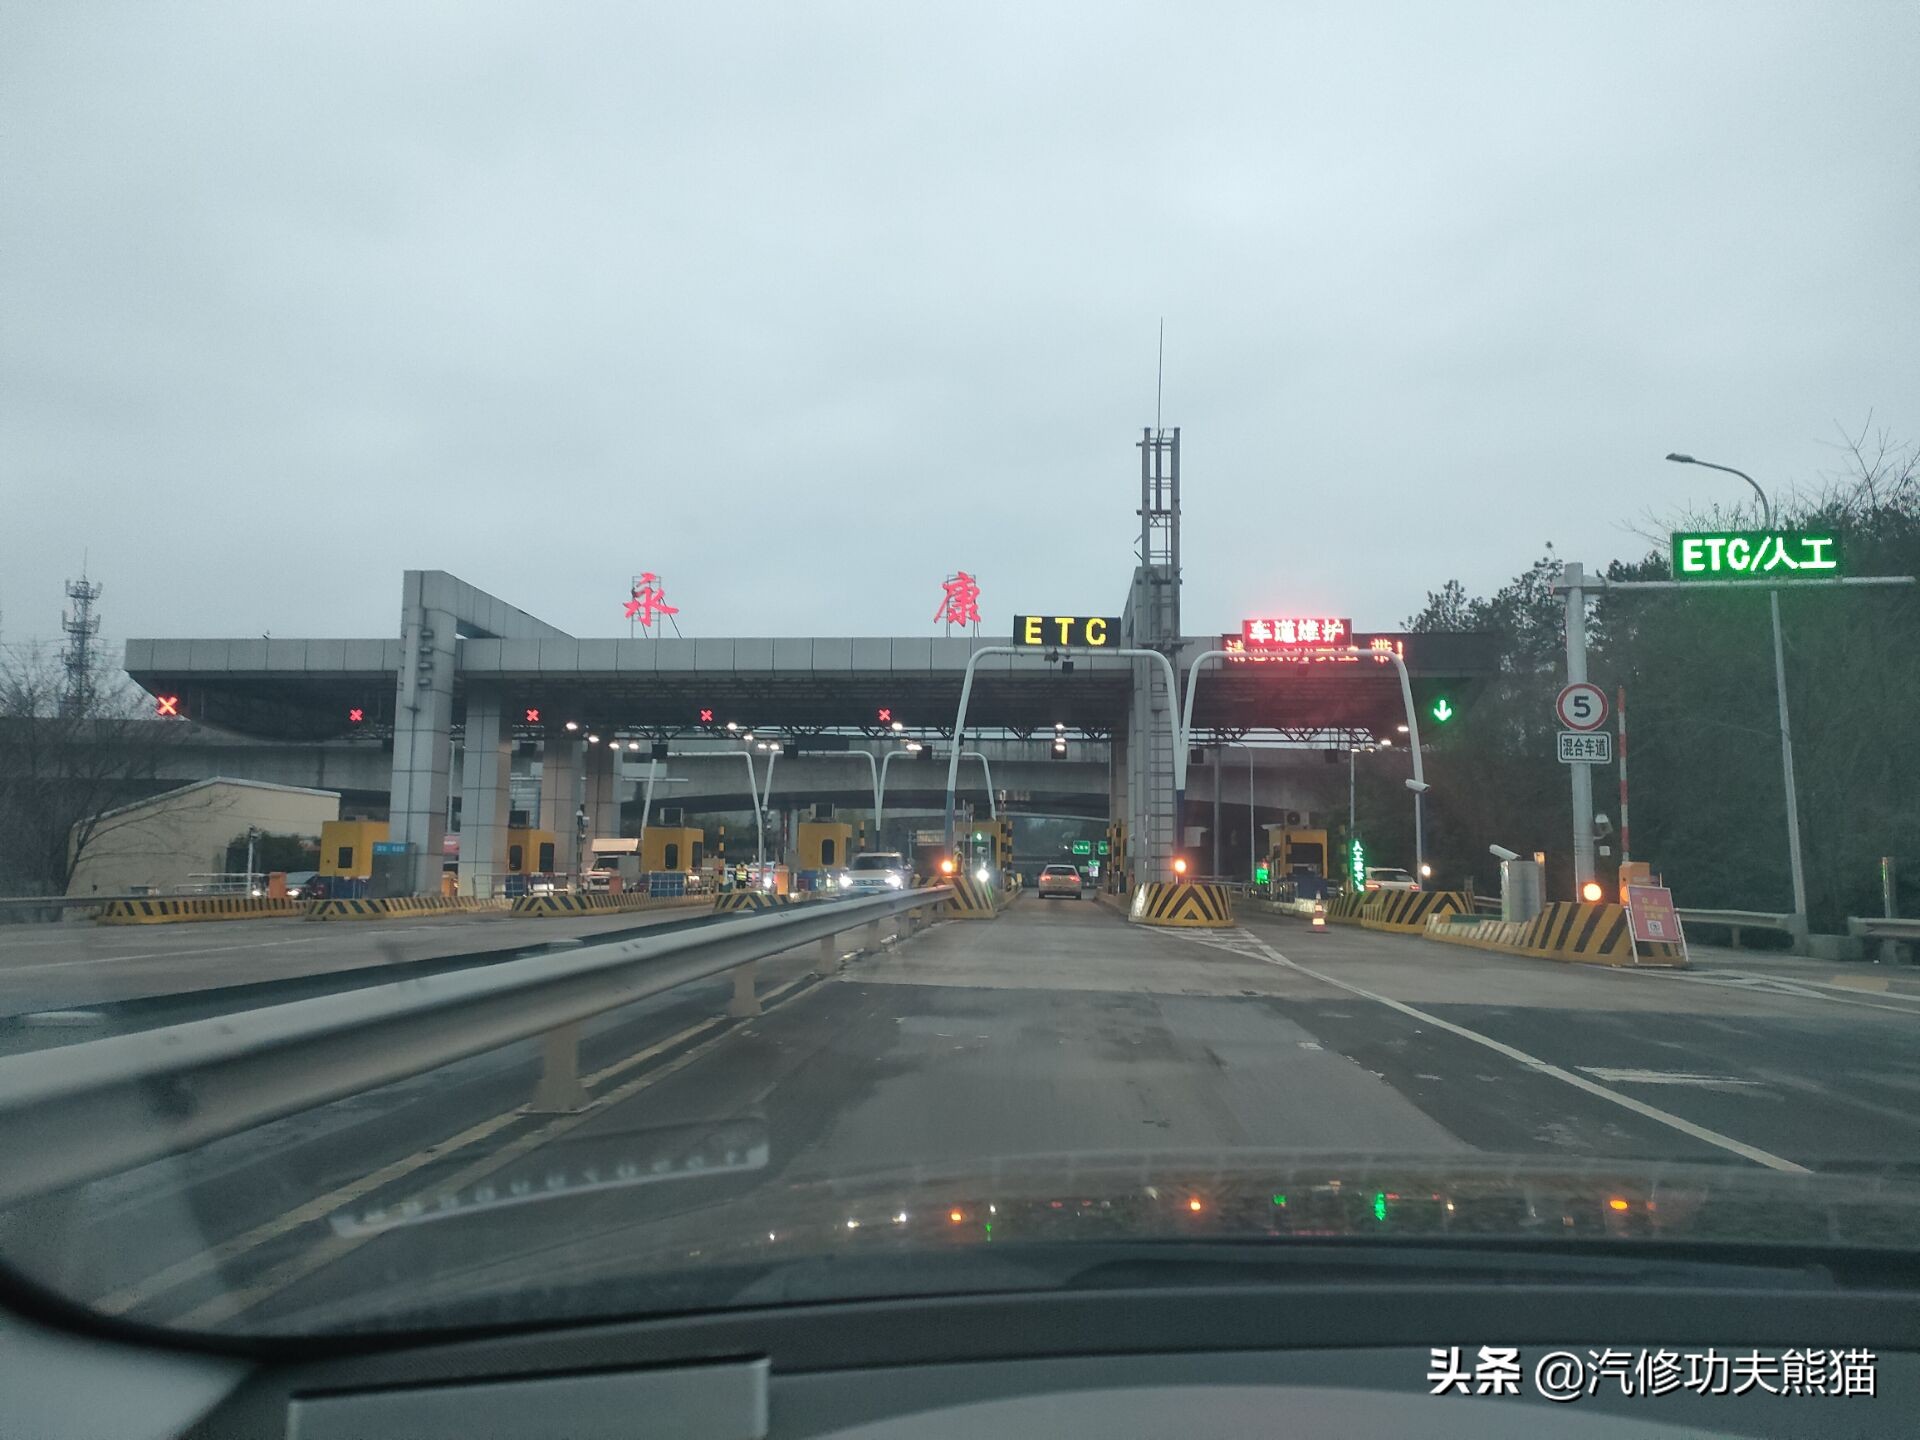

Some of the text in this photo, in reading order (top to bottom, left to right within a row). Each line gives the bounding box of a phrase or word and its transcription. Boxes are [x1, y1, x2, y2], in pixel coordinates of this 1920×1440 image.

[1682, 536, 1837, 572] ETC/人工
[623, 571, 982, 628] 永 康
[1025, 616, 1107, 646] ETC
[1249, 618, 1345, 644] 车道维护
[1573, 695, 1592, 719] 5
[1562, 737, 1607, 758] 混合车道
